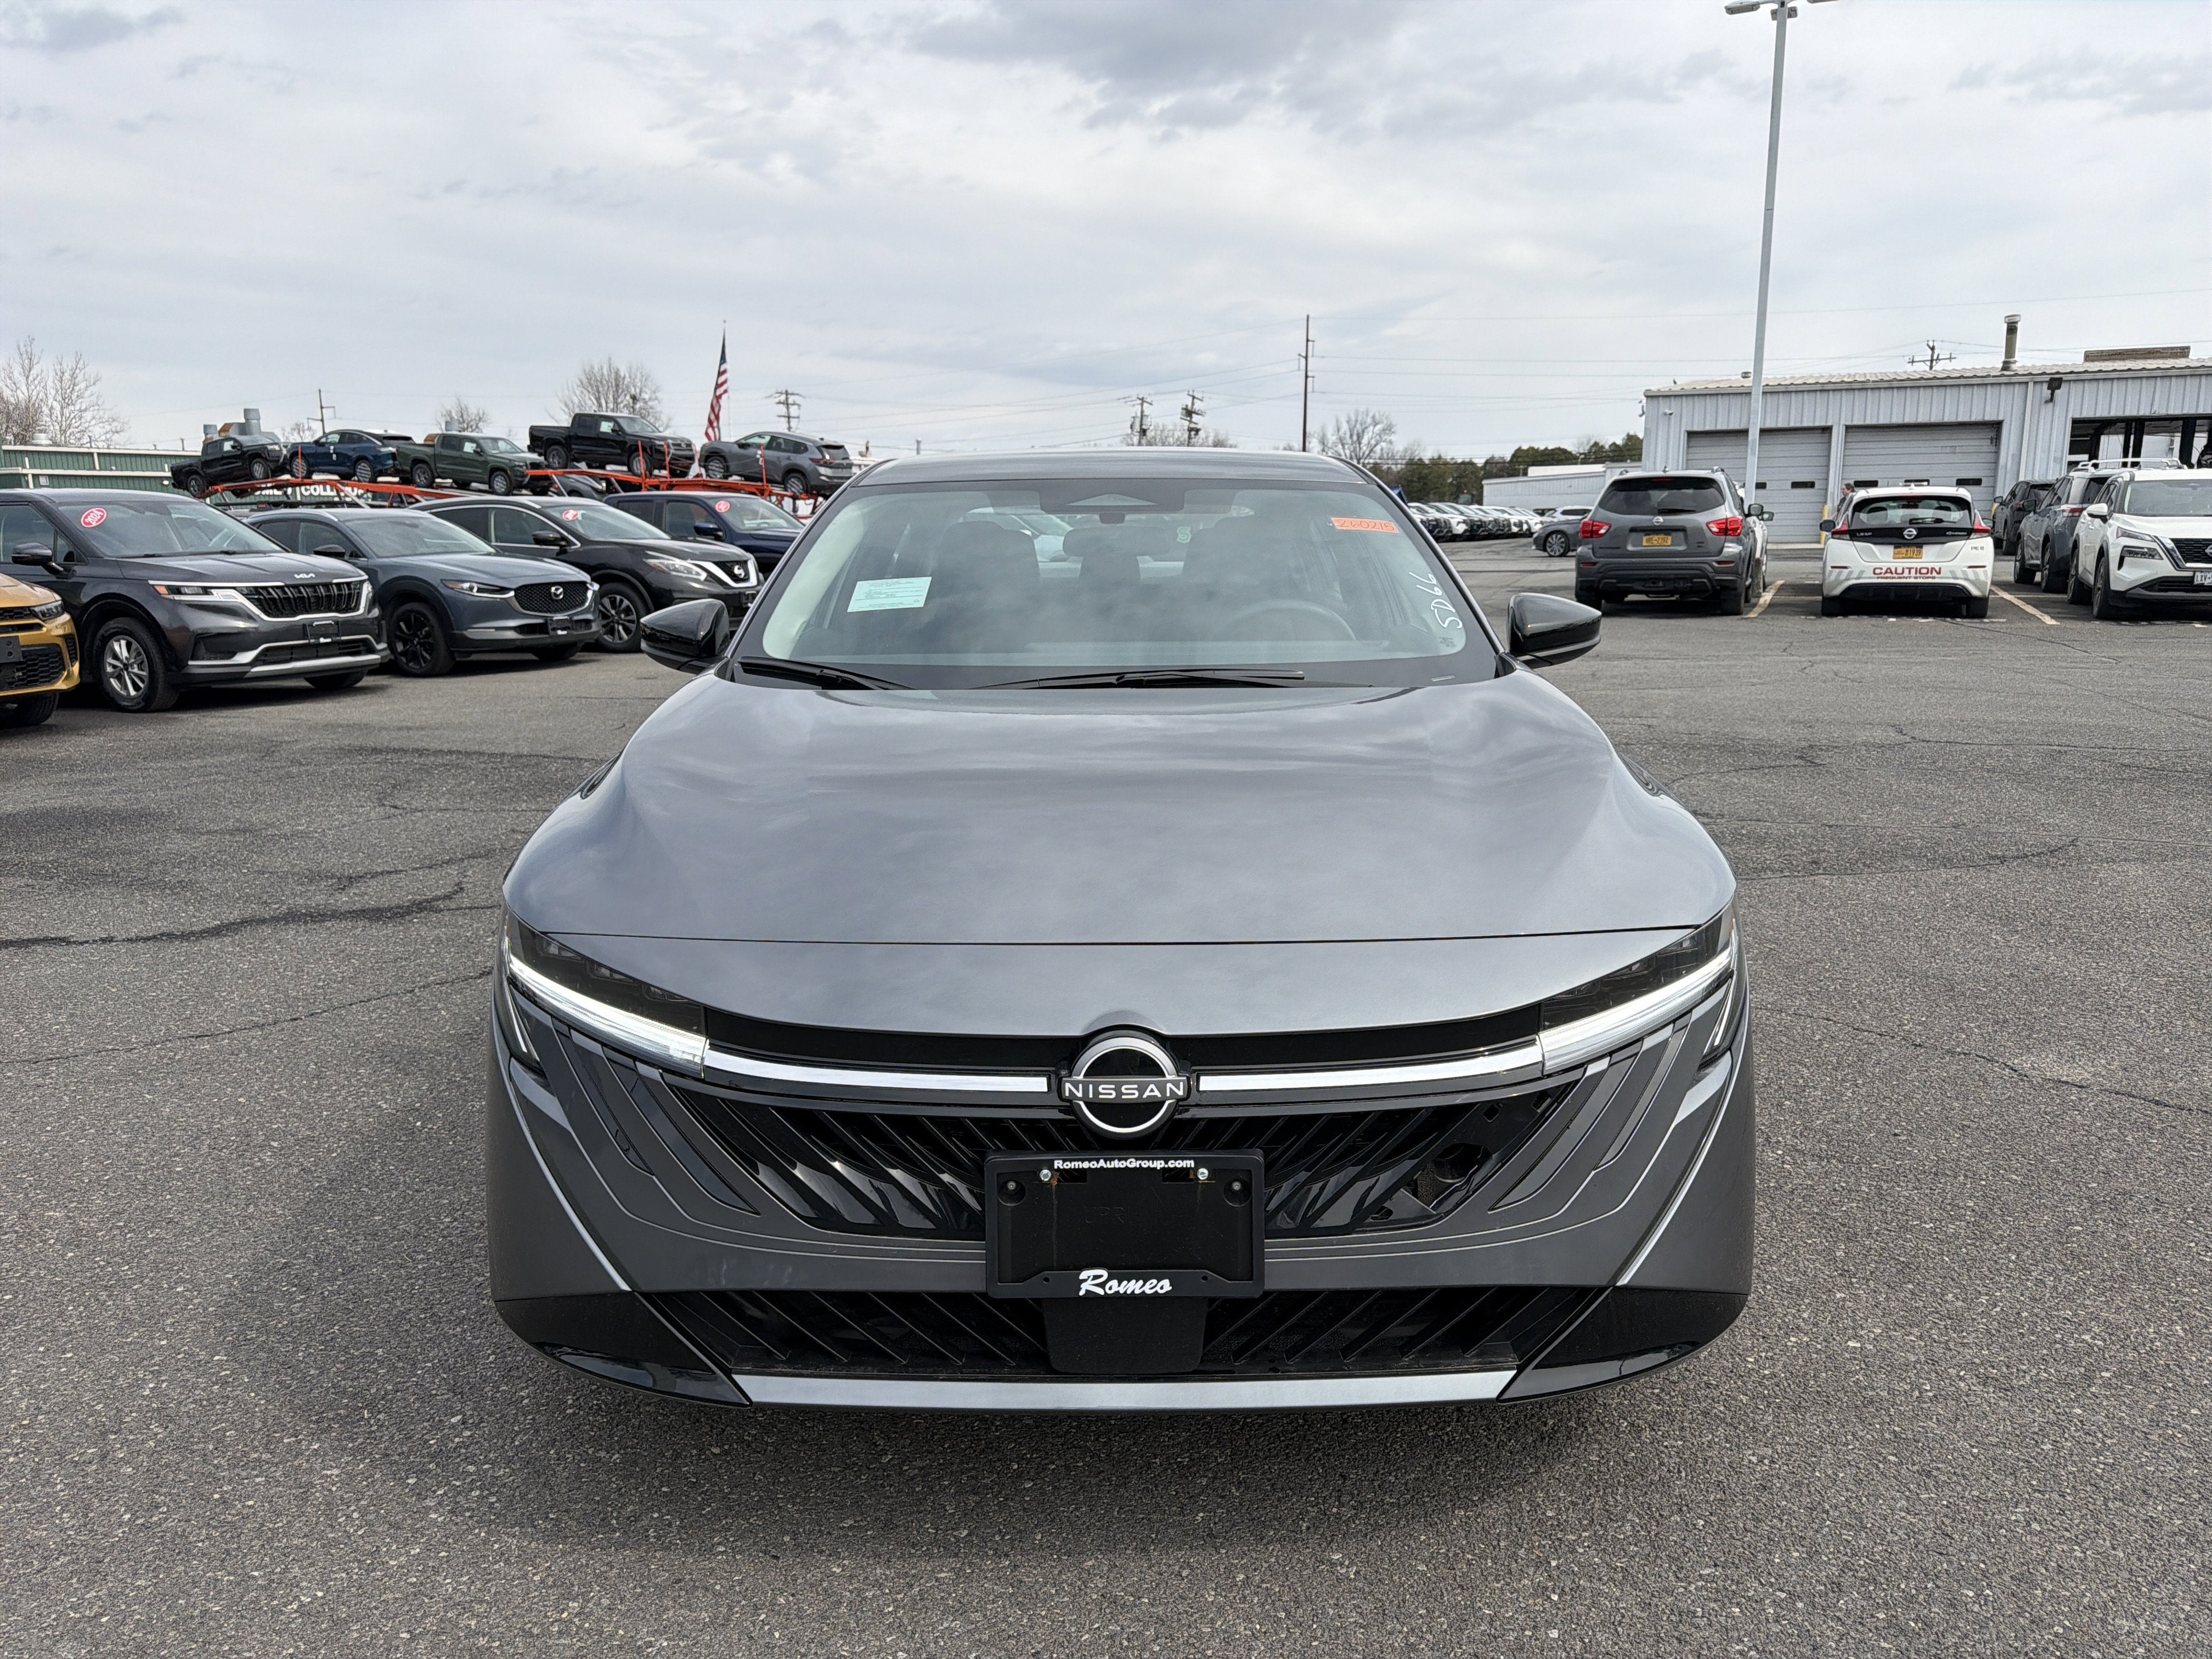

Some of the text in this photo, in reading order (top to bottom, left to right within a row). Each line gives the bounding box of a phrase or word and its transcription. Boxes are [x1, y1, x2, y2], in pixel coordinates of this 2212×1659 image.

[1340, 521, 1394, 532] 260215
[1872, 567, 1942, 575] CAUTION
[1065, 1082, 1183, 1098] NISSAN
[1054, 1158, 1194, 1170] RomeoAutoGroup.com
[1079, 1269, 1172, 1296] Romeo
